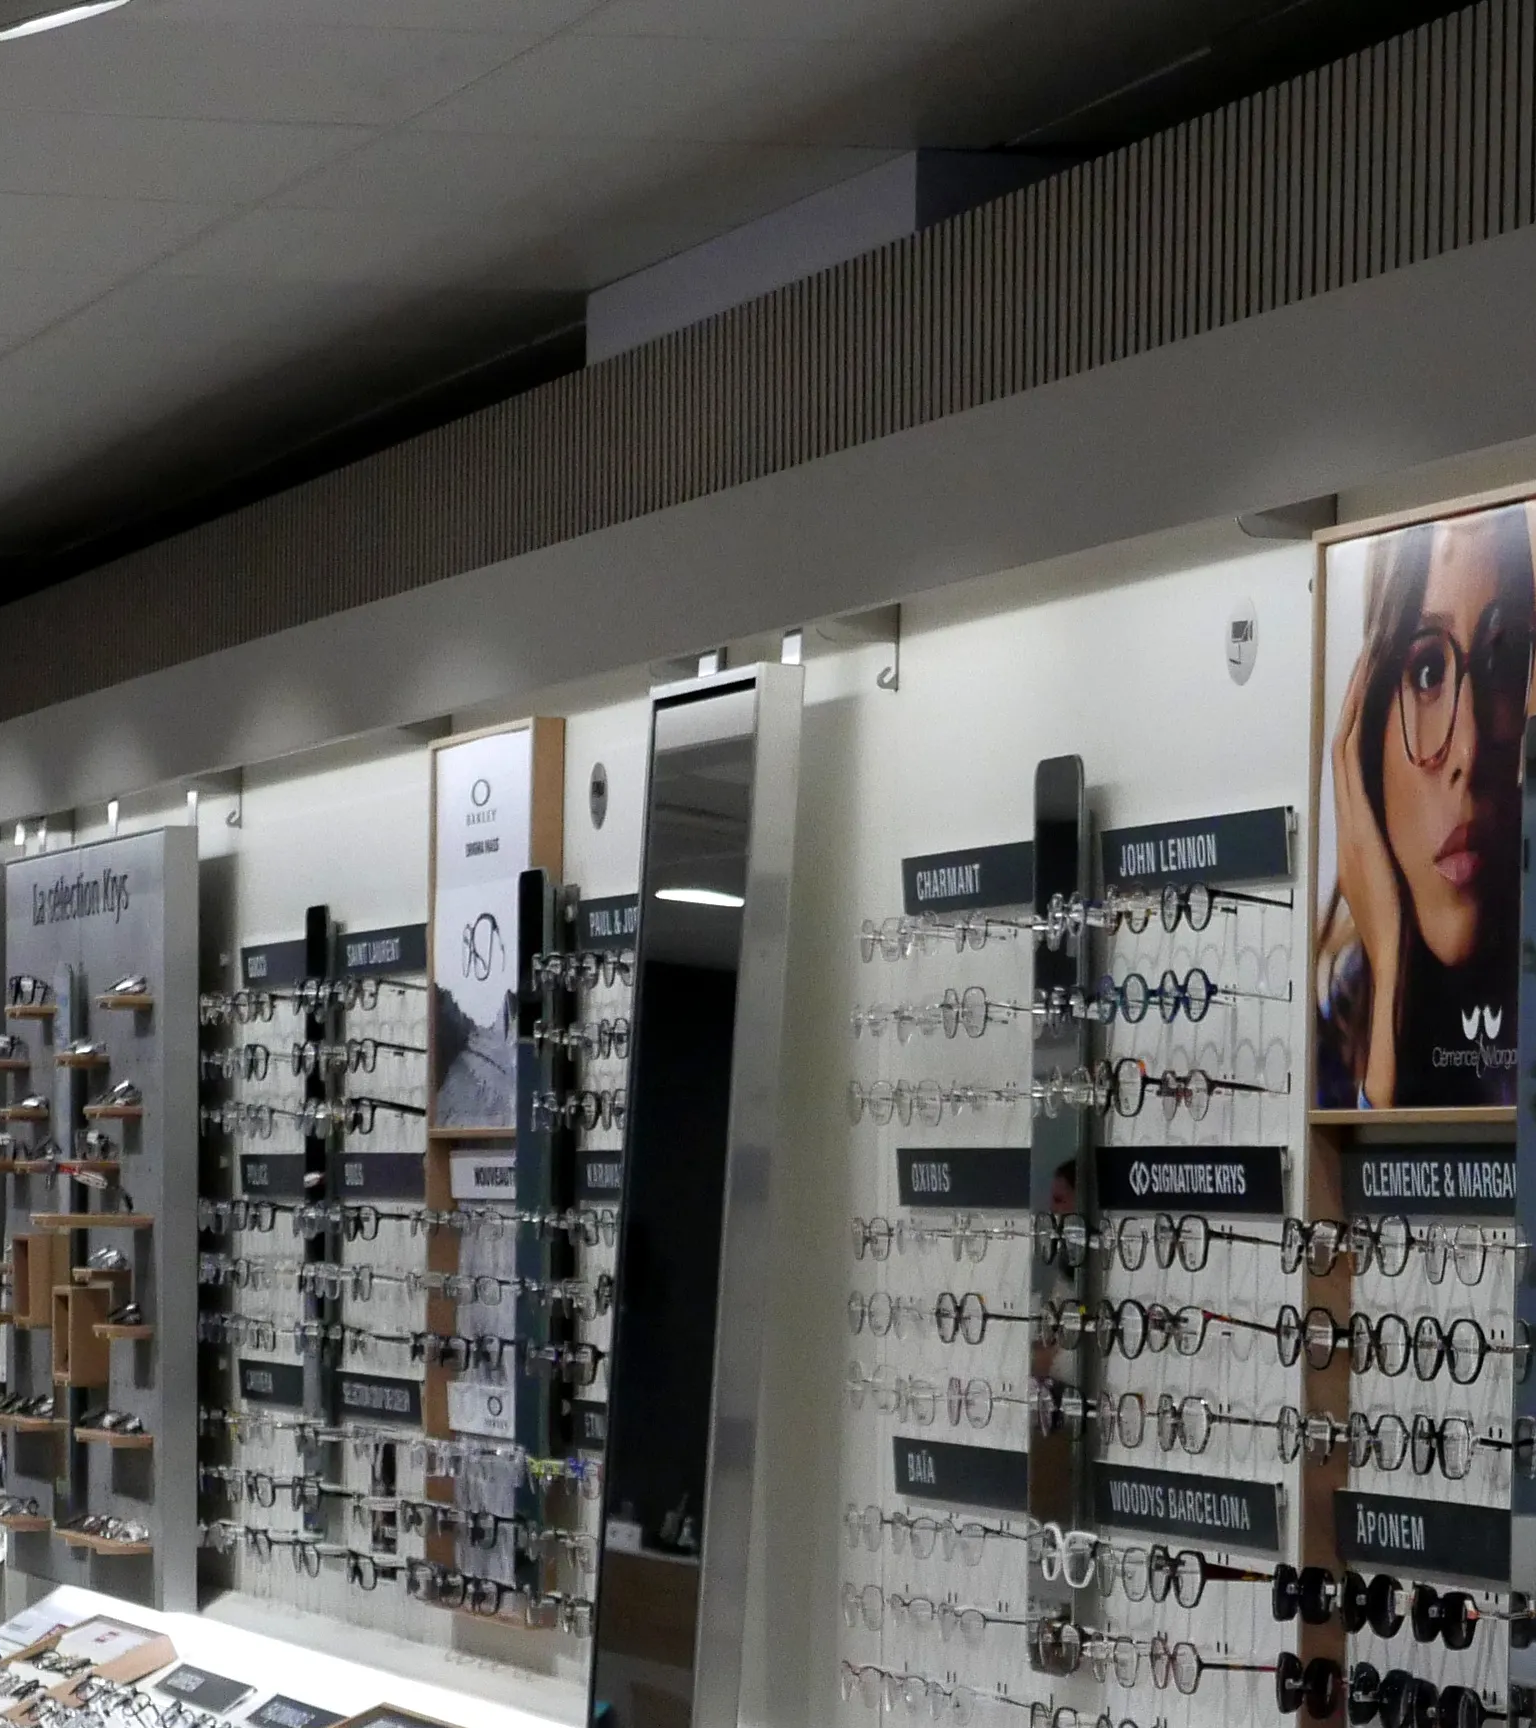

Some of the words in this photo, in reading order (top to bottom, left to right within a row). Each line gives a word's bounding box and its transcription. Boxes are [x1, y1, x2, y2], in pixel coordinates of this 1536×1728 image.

[1119, 844, 1156, 877] JOHN
[1159, 833, 1217, 873] LENNON
[916, 863, 981, 900] CHARMANT
[911, 1162, 951, 1193] OXIBIS
[1151, 1163, 1214, 1194] SIGNATURE
[1215, 1163, 1247, 1195] KRYS
[1362, 1161, 1440, 1198] CLEMENCE
[1443, 1162, 1455, 1198] &
[1109, 1480, 1165, 1518] WOODYS
[1167, 1486, 1251, 1531] BARCELONA
[1357, 1503, 1425, 1550] ÄPONEM
